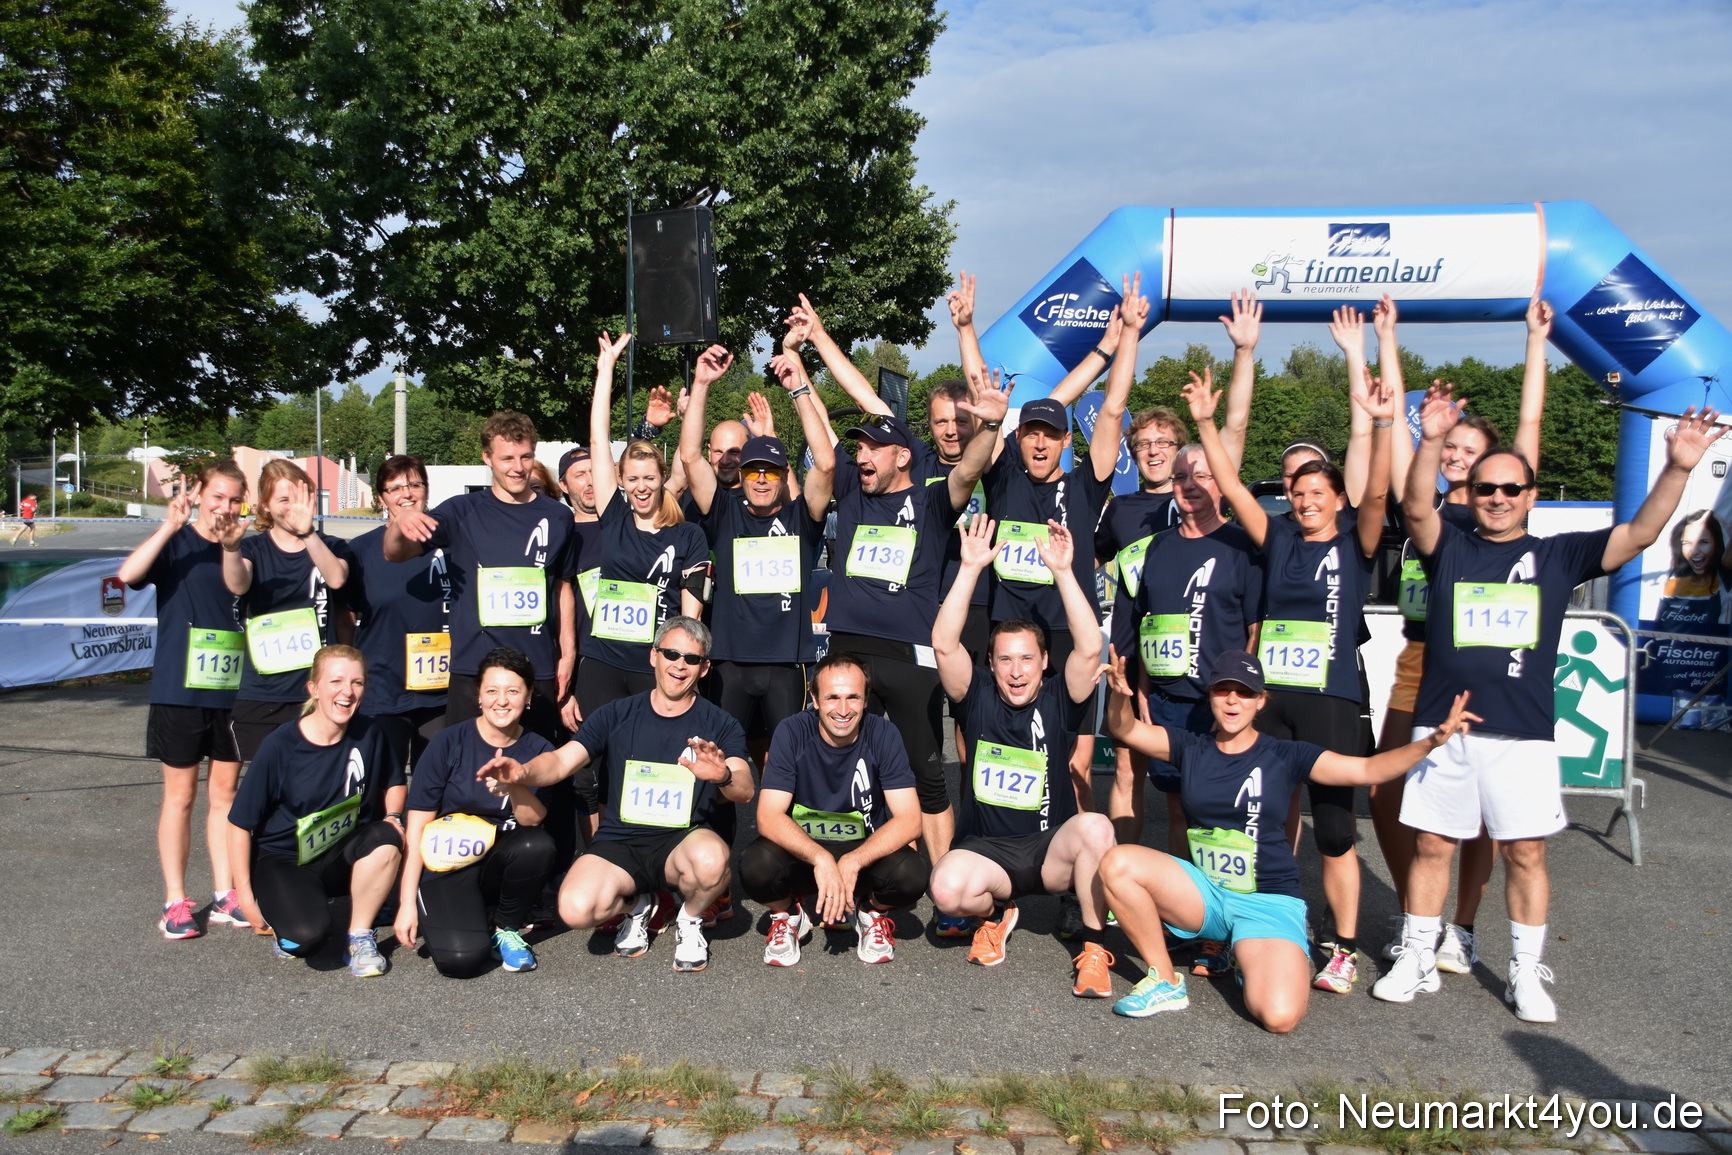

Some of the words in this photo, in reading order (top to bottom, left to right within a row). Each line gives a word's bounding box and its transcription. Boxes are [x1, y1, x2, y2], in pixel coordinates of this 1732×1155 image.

[1304, 258, 1445, 283] firmenlauf
[1303, 285, 1360, 294] neumarkt
[857, 546, 905, 566] 1138
[742, 559, 793, 577] 1135
[487, 591, 539, 609] 1139
[601, 603, 648, 626] 1130
[1464, 608, 1528, 628] 1147
[258, 632, 313, 658] 1146
[1187, 592, 1207, 678] RAIL.ONE
[1143, 639, 1183, 659] 1145
[1266, 646, 1320, 668] 1132
[1657, 646, 1720, 659] Fischer
[197, 653, 240, 673] 1131
[1662, 659, 1715, 667] AUTOMOBILE
[981, 767, 1037, 793] 1127
[631, 787, 682, 810] 1141
[306, 813, 352, 849] 1134
[802, 822, 858, 835] 1143
[430, 835, 486, 857] 1150
[1196, 847, 1246, 876] 1129
